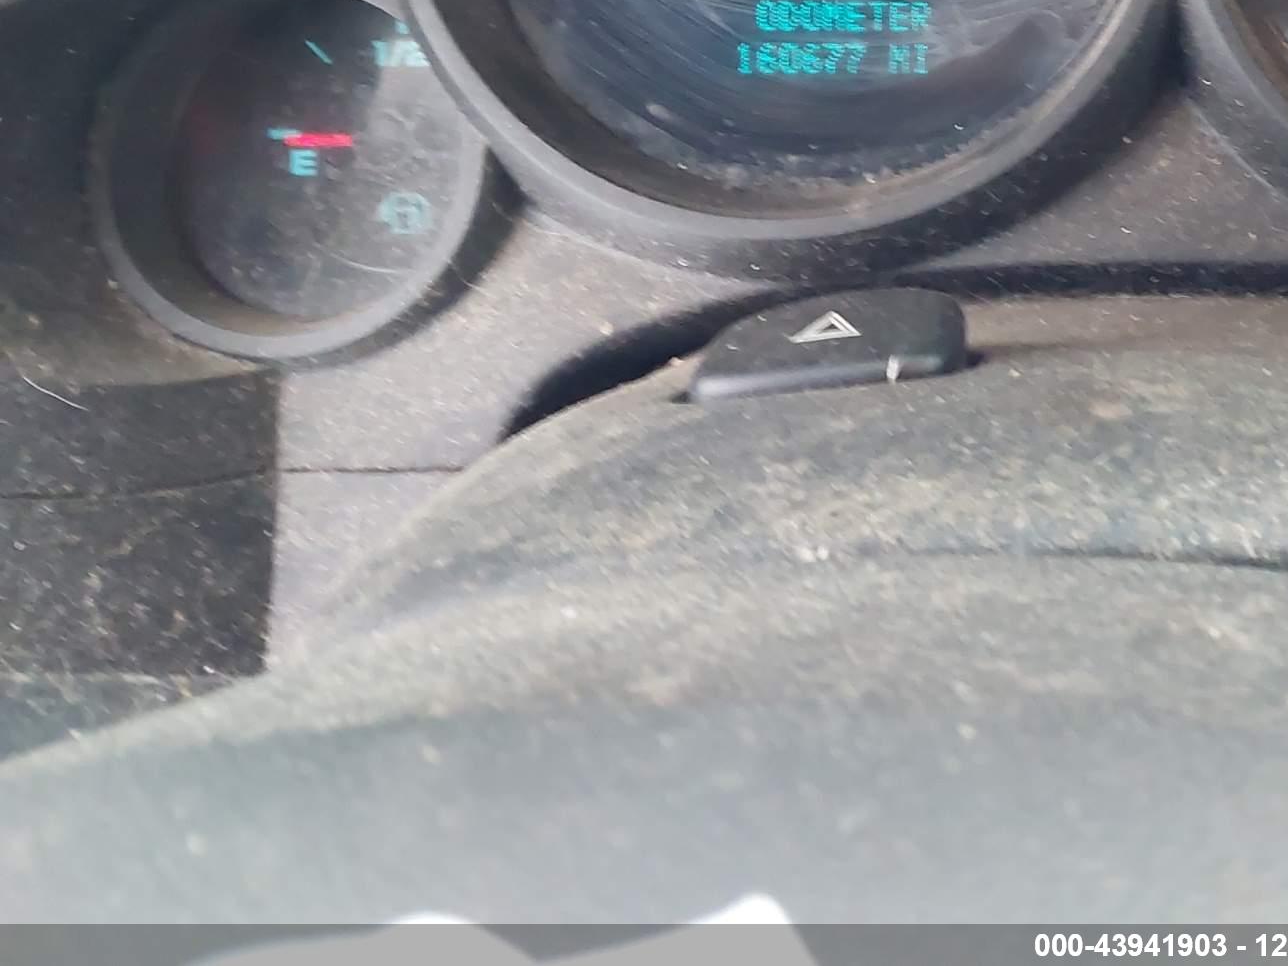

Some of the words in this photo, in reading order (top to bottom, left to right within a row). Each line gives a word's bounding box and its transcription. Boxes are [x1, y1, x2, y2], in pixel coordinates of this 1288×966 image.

[755, 0, 931, 32] ODOMETER
[888, 42, 929, 75] MI
[289, 149, 318, 176] E
